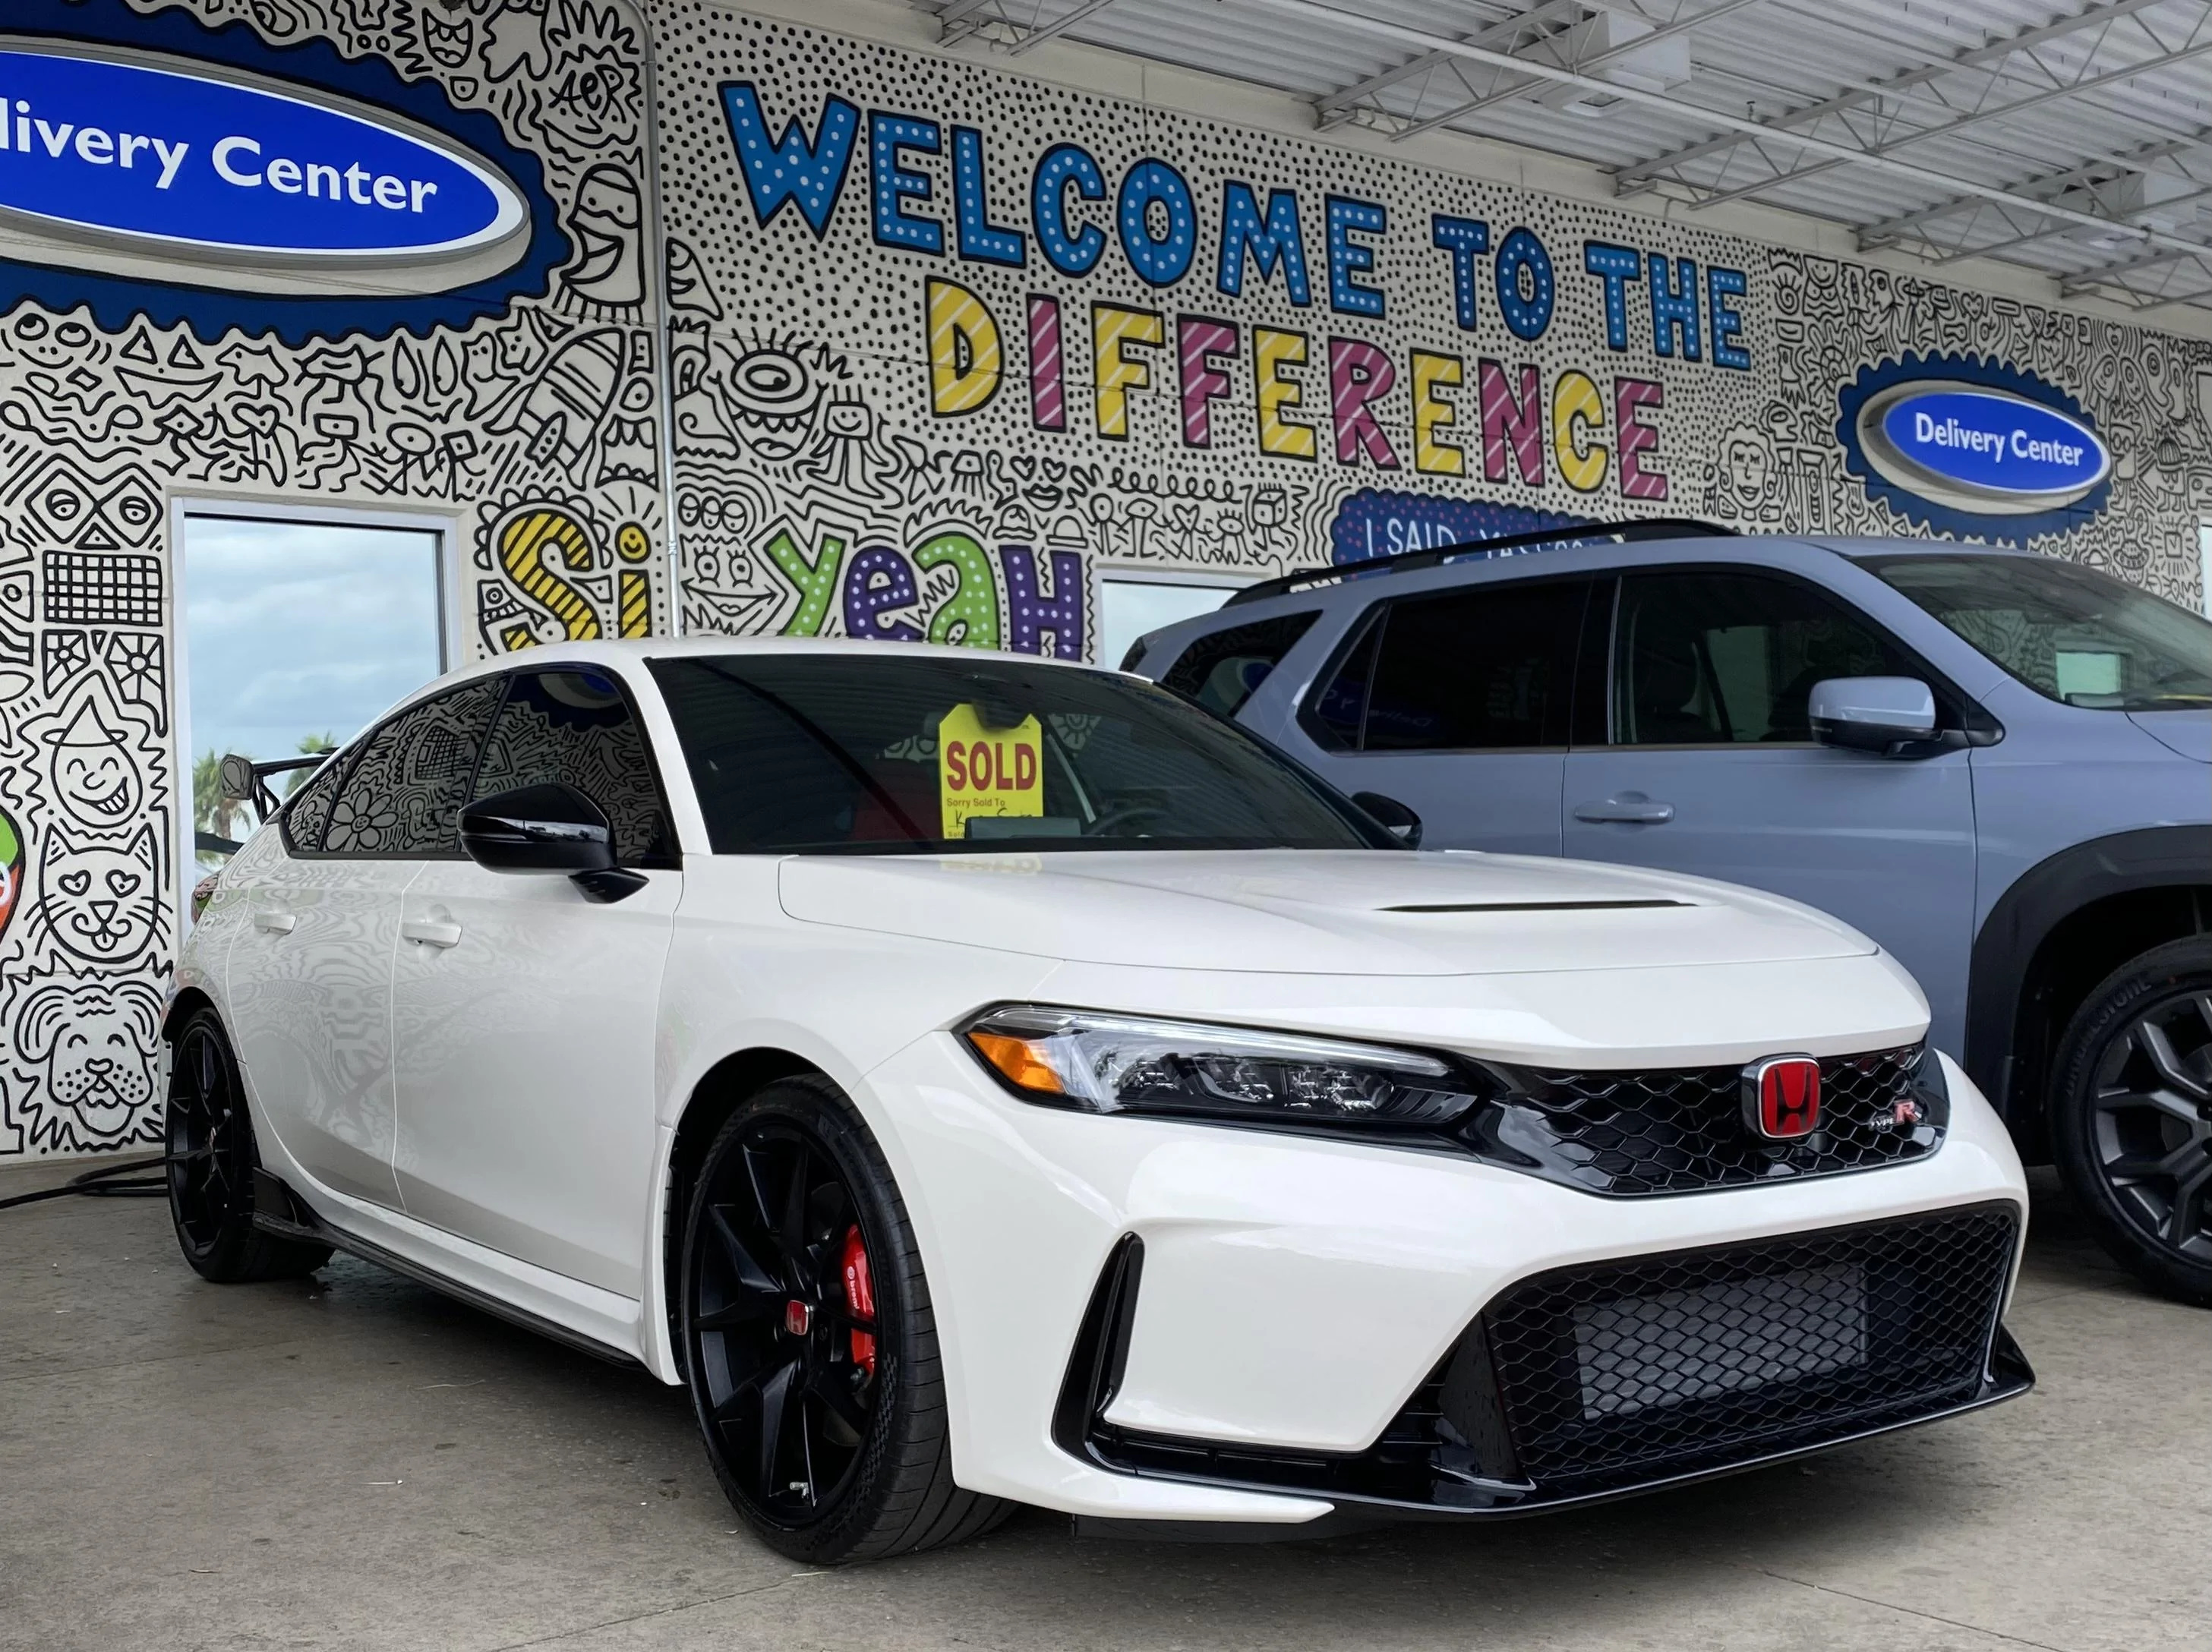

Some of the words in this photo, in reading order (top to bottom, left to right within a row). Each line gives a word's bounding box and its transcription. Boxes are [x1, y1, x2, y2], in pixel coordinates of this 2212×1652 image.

[211, 134, 438, 213] Center
[717, 80, 1387, 320] WELCOME
[1432, 213, 1554, 342] TO
[1584, 240, 1751, 370] THE
[924, 276, 1668, 501] DIFFERENCE
[1915, 411, 2005, 463] Delivery
[2011, 429, 2084, 467] Center
[1365, 518, 1374, 557] I
[947, 740, 1037, 791] SOLD
[947, 798, 970, 809] Sorry
[973, 798, 992, 807] Sold
[994, 798, 1005, 806] To
